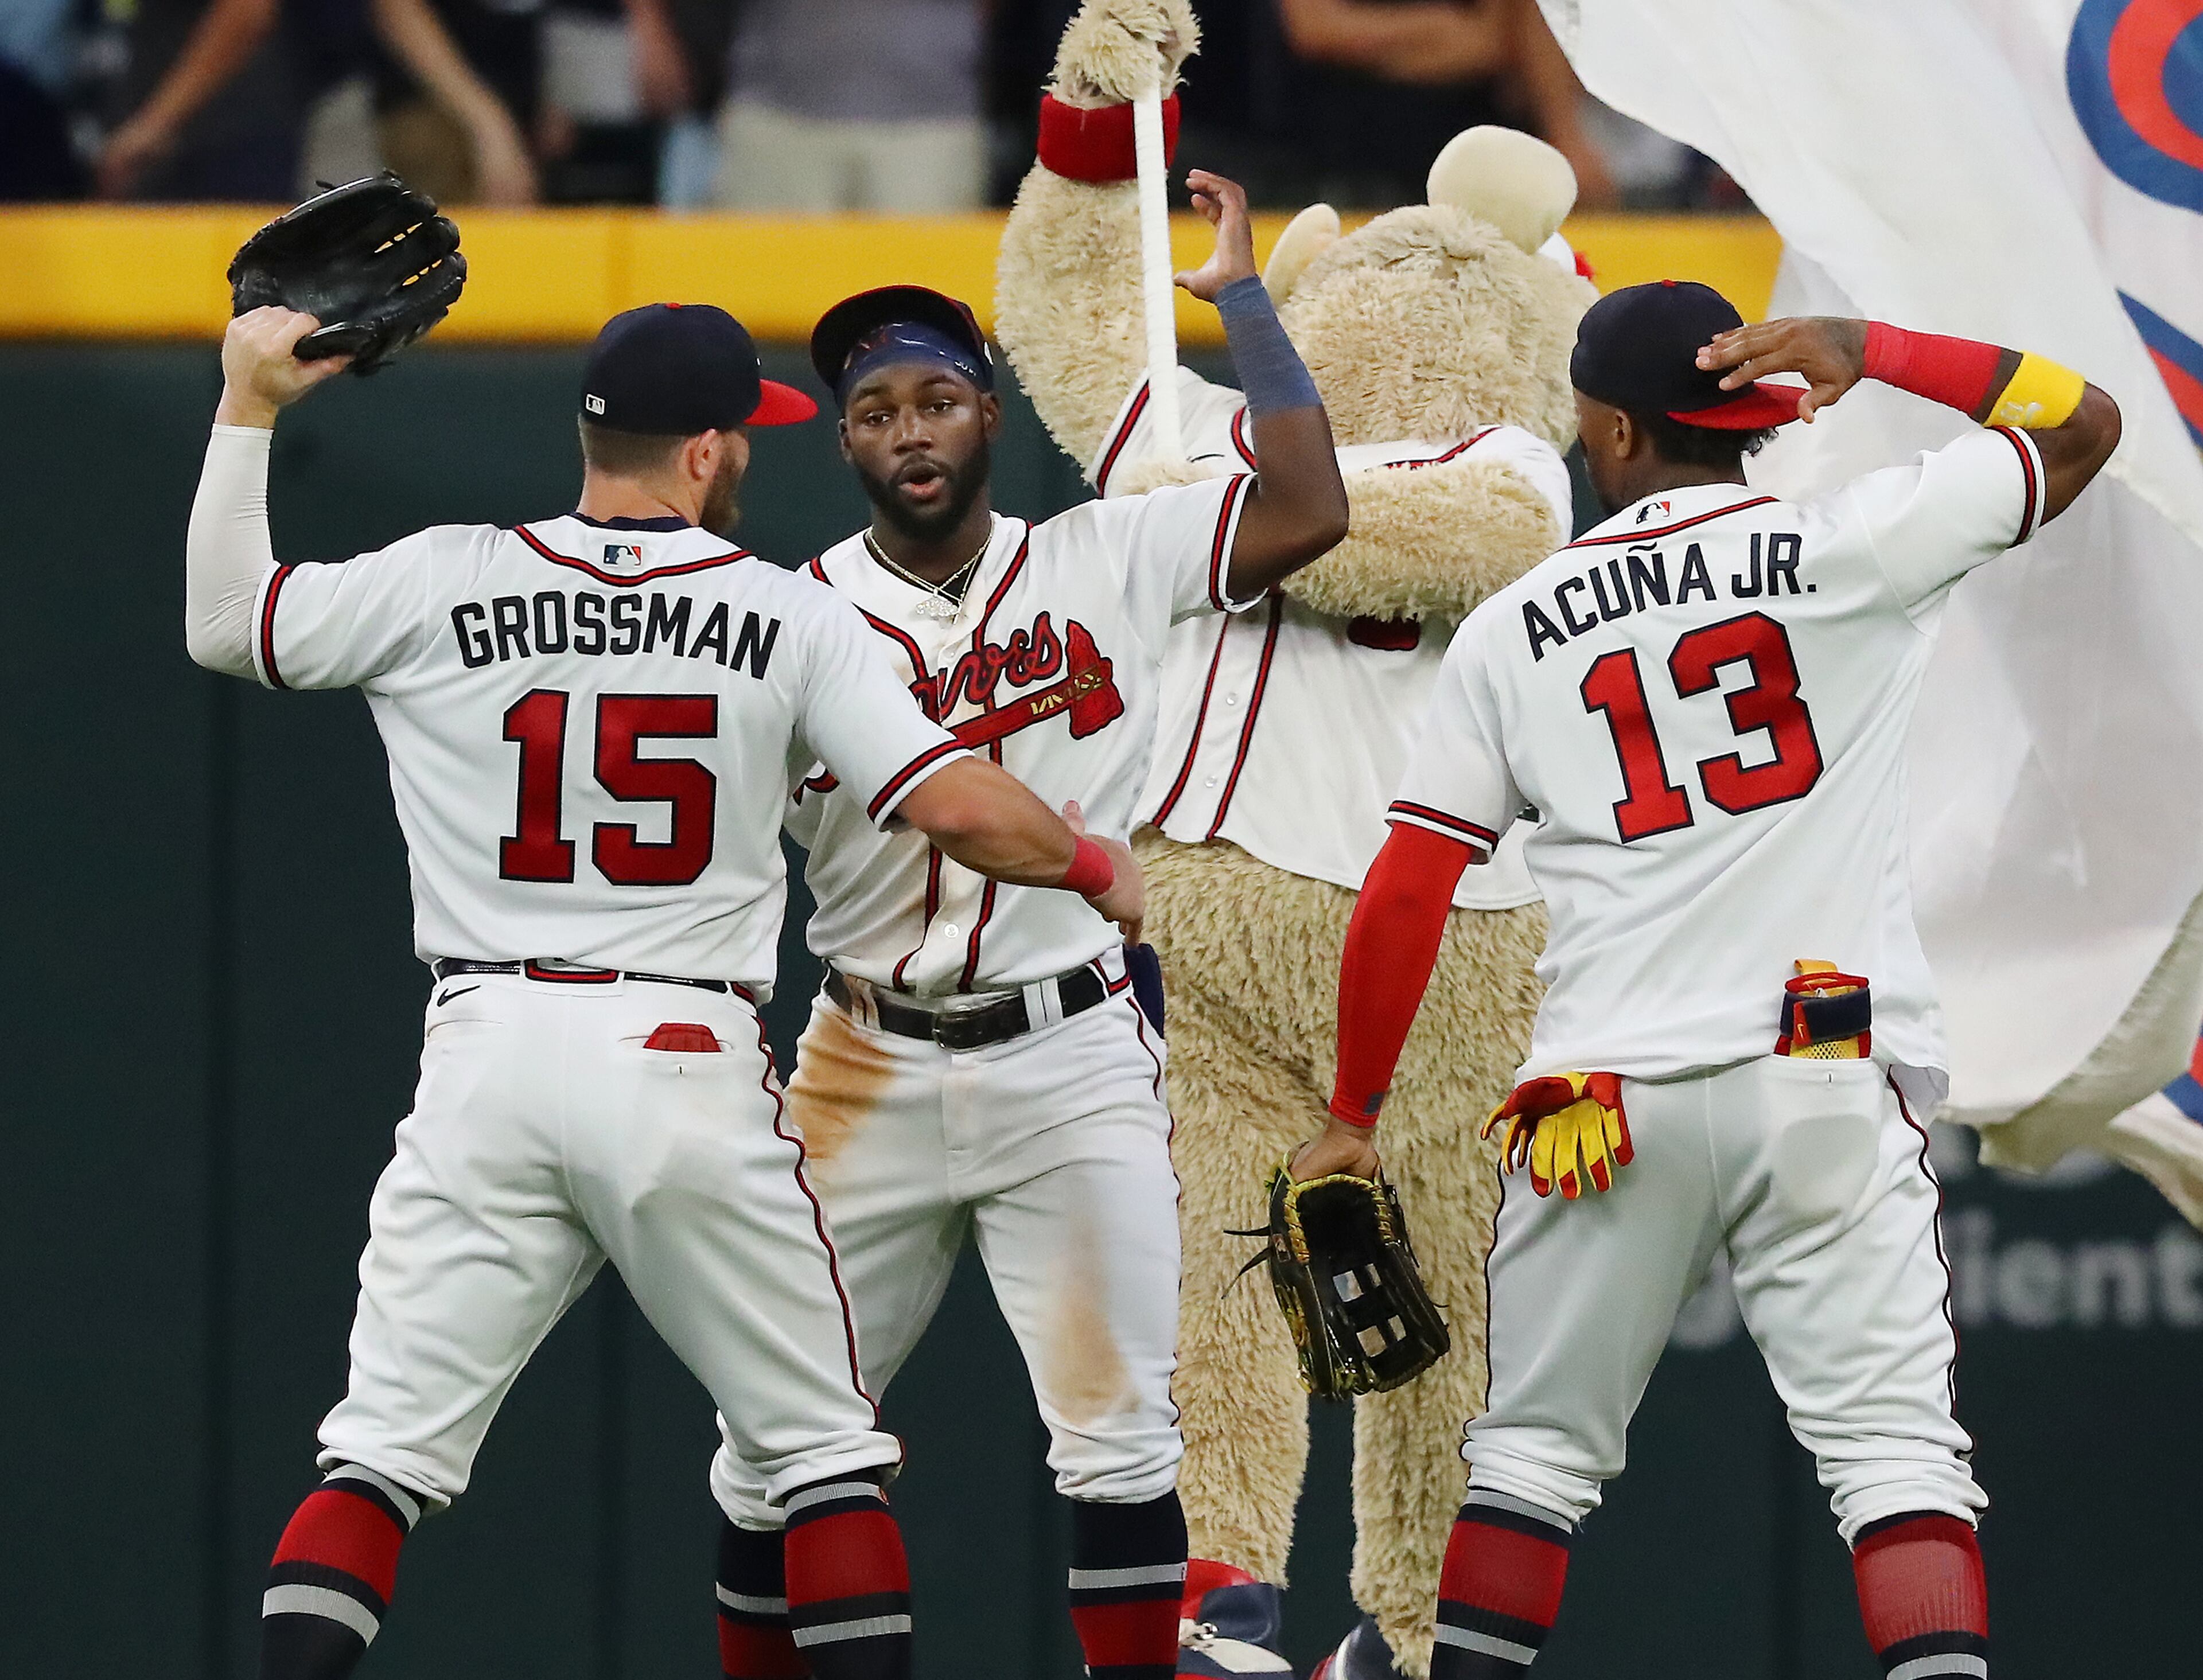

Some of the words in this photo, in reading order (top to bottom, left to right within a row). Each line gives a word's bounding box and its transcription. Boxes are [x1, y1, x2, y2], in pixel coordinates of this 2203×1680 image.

[451, 591, 781, 680] GROSSMAN
[1522, 542, 1717, 662] ACUÑA
[1731, 533, 1816, 598] JR.
[908, 610, 1062, 724] aves
[1580, 611, 1824, 844] 13
[499, 688, 718, 886] 15
